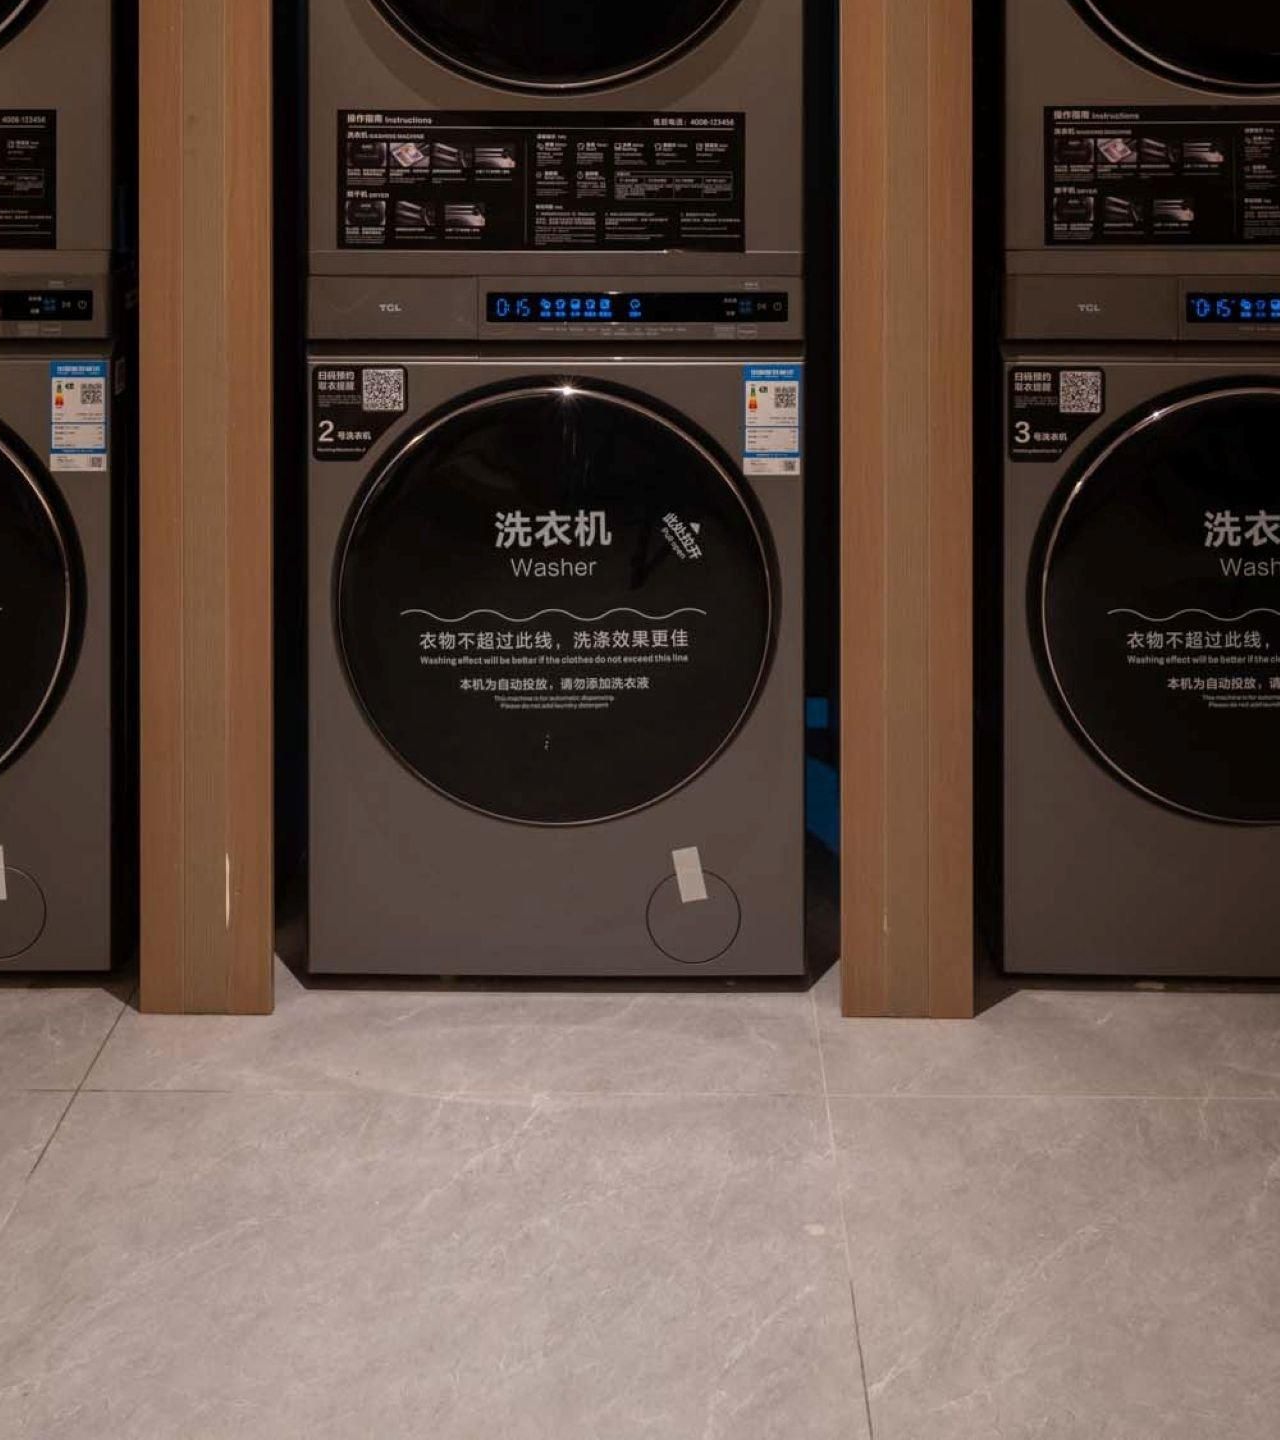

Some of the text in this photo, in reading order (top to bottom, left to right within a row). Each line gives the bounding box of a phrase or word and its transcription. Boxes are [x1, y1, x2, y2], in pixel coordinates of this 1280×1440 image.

[378, 303, 402, 312] TCL
[1077, 303, 1101, 312] TCL
[318, 421, 372, 442] 2 号洗衣机
[1014, 421, 1031, 443] 3
[495, 510, 612, 547] 洗衣机
[511, 558, 596, 576] Washer
[420, 630, 688, 649] 衣物不超过此线，洗涤效果更佳
